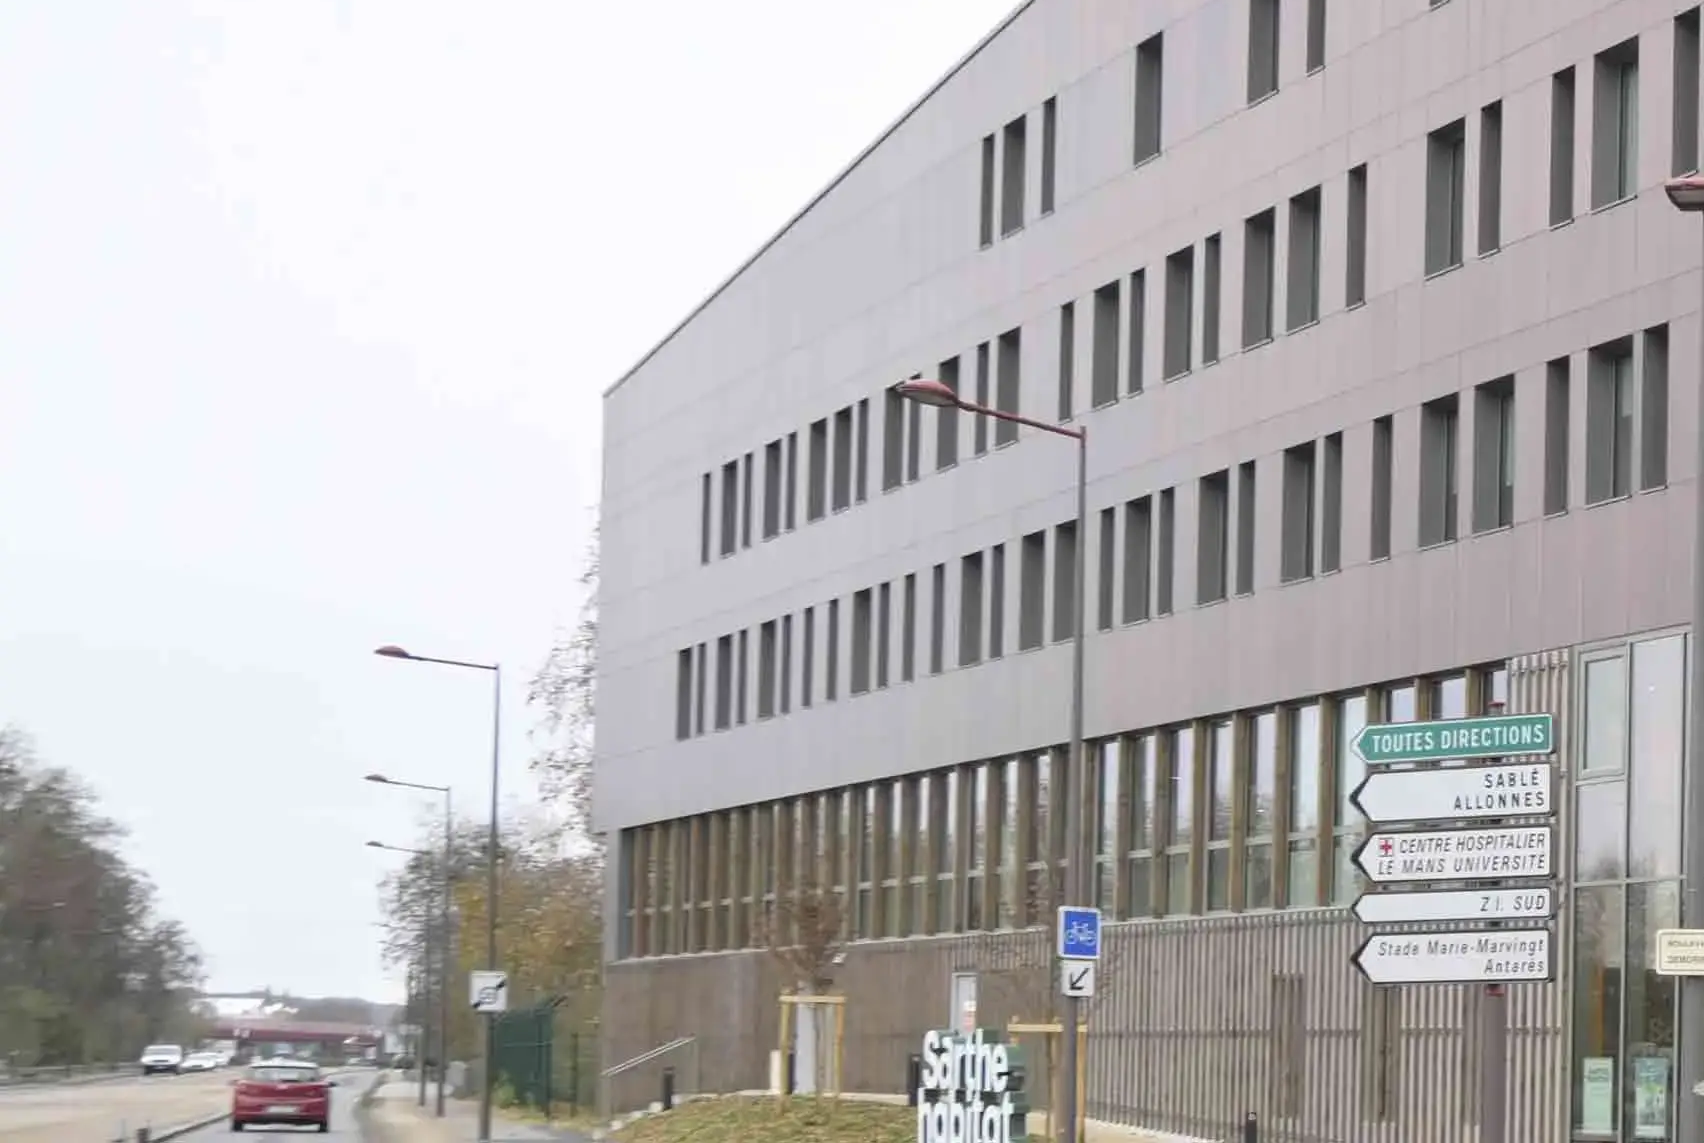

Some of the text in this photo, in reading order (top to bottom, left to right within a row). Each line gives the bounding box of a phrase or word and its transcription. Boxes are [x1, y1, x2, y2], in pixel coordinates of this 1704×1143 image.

[1372, 724, 1545, 753] TOUTES DIRECTIONS
[1484, 768, 1540, 789] SABLÉ
[1453, 791, 1545, 811] ALLONNES
[1399, 832, 1546, 854] CENTRE HOSPITALIER
[1377, 860, 1394, 875] LE
[1401, 858, 1446, 873] MANS
[1512, 895, 1546, 911] SUD
[1378, 937, 1545, 956] Stade Marie-Marvingt
[1484, 959, 1545, 974] Antarès
[922, 1028, 1009, 1093] Sarthe
